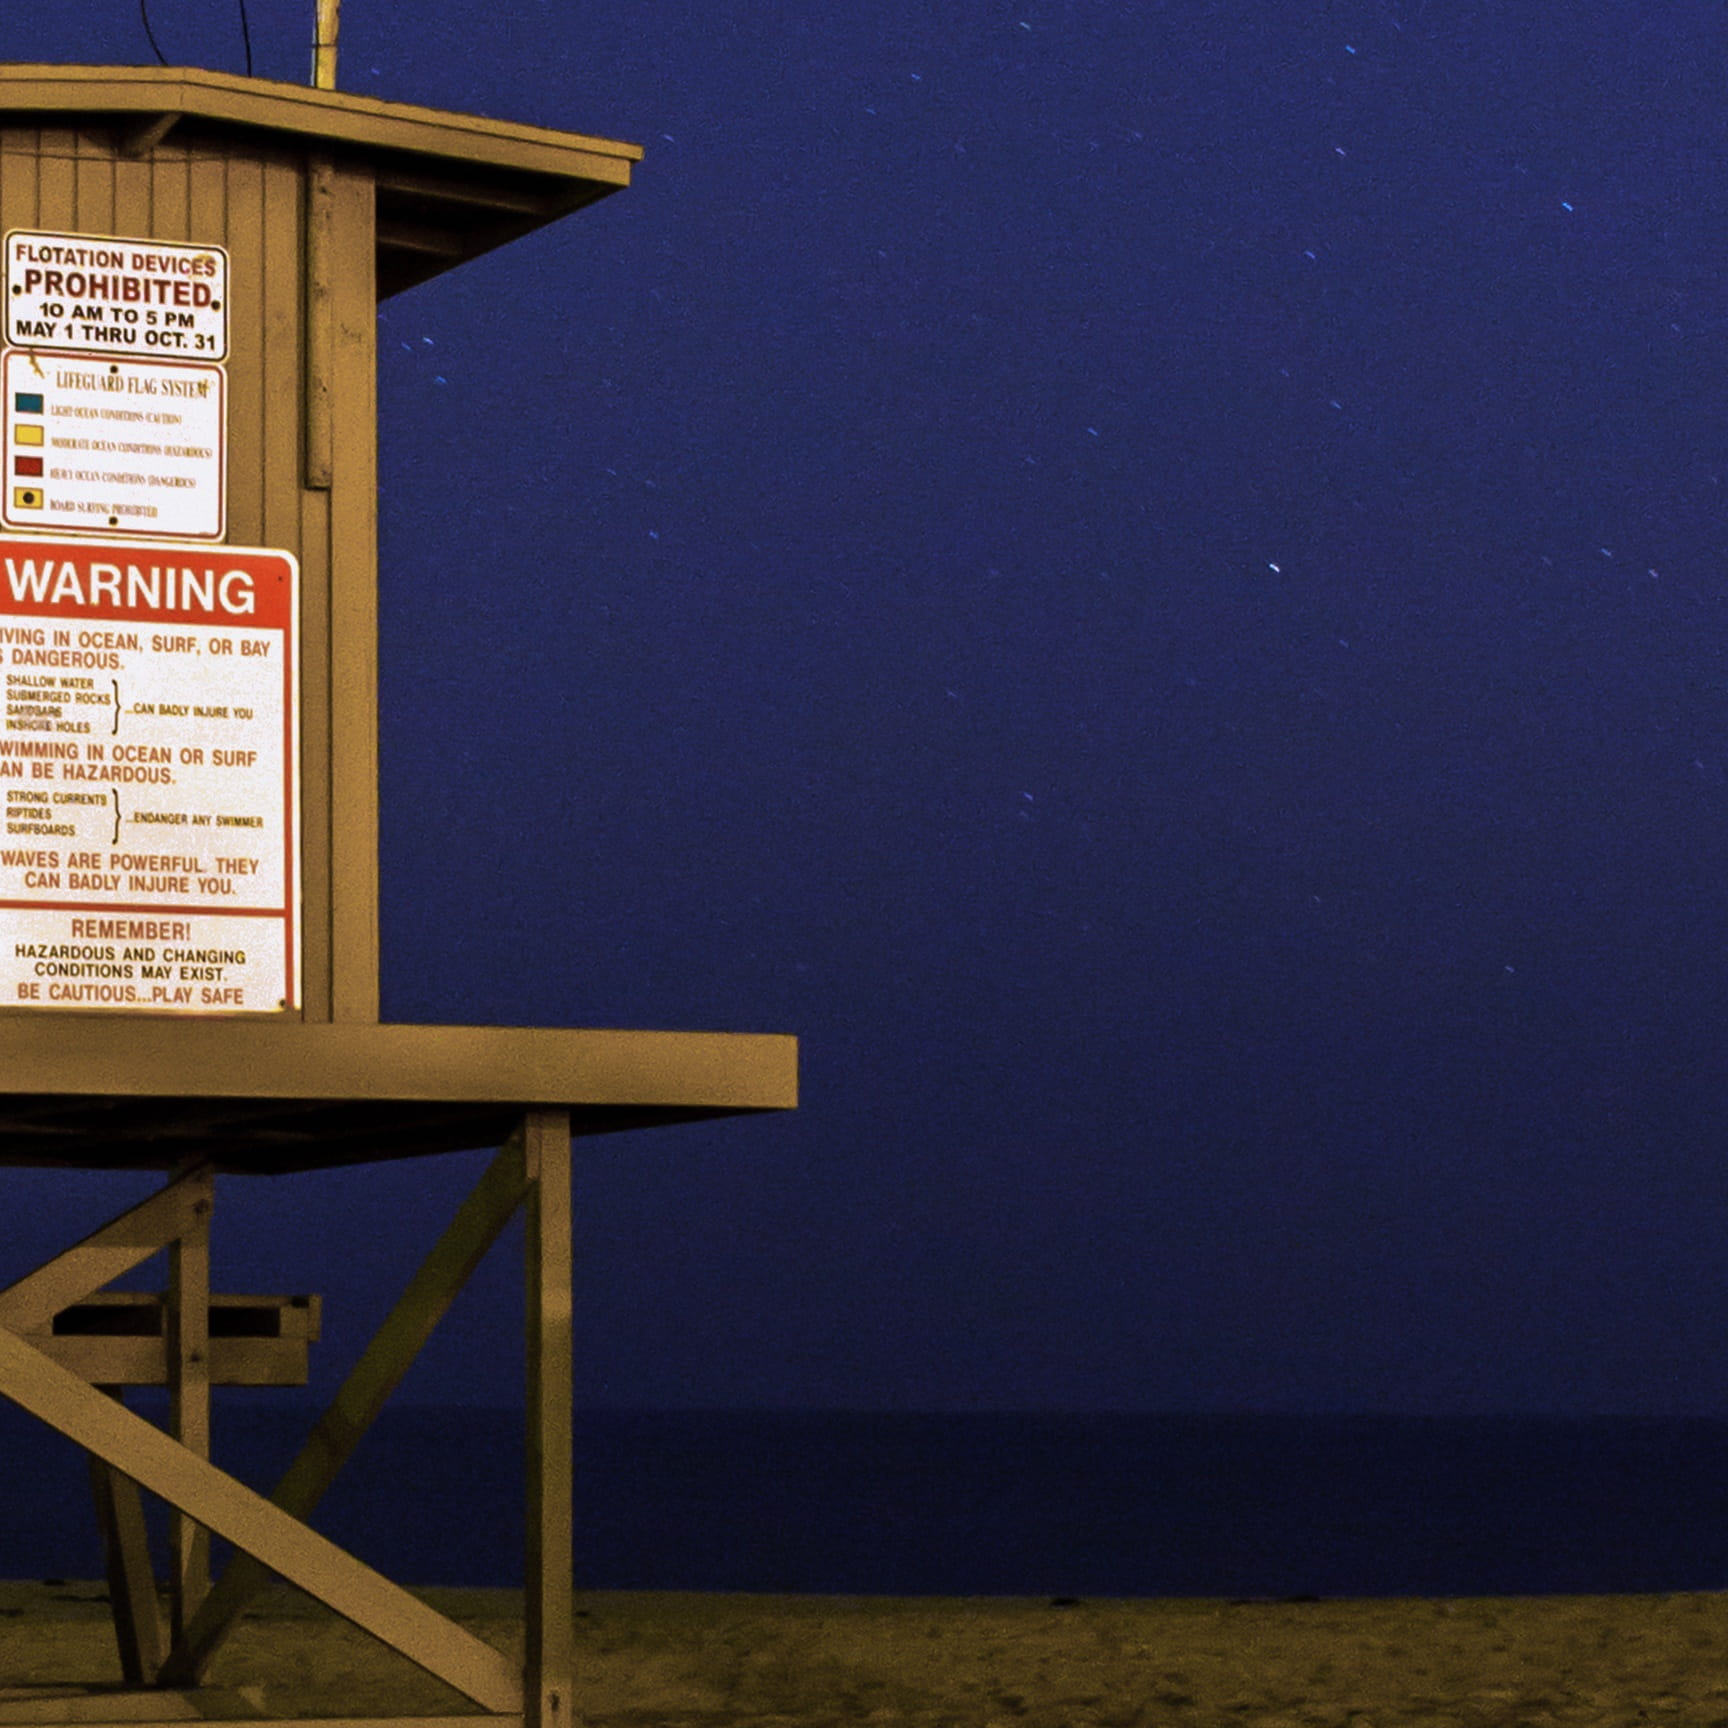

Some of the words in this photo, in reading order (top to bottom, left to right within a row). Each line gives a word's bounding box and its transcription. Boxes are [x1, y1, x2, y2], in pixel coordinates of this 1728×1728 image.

[16, 244, 124, 269] FLOTATION
[132, 253, 217, 277] DEVICES
[24, 269, 212, 308] PROHIBITED
[39, 302, 64, 318] 10
[71, 305, 104, 321] AM
[110, 307, 139, 324] TO
[146, 311, 158, 325] 5
[165, 312, 194, 328] PM
[16, 320, 58, 337] MAY
[64, 324, 73, 339] 1
[81, 325, 136, 343] THRU
[145, 330, 188, 348] OCT.
[195, 334, 215, 351] 31
[56, 371, 124, 391] LIFEGUARD
[128, 377, 157, 395] FLAG
[161, 381, 209, 399] SYSTEM
[5, 558, 256, 614] WARNING
[53, 630, 70, 647] IN
[80, 631, 143, 652] OCEAN,
[152, 635, 201, 655] SURF,
[208, 638, 233, 655] OR
[241, 639, 271, 658] BAY
[12, 649, 125, 670] DANGEROUS.
[5, 674, 57, 688] SHALLOW
[60, 677, 94, 689] WATER
[5, 690, 71, 704] SUBMERGED
[75, 692, 112, 705] ROCKS
[159, 705, 189, 717] BADLY
[193, 706, 229, 718] INJURE
[233, 708, 254, 719] YOU
[55, 722, 91, 734] HOLES
[86, 744, 104, 760] IN
[112, 745, 172, 763] OCEAN
[179, 748, 204, 764] OR
[212, 750, 257, 767] SURF
[32, 762, 54, 779] BE
[63, 763, 177, 785] HAZARDOUS.
[6, 791, 49, 803] STRONG
[52, 793, 107, 806] CURRENTS
[6, 807, 52, 819] RIPTIDES
[192, 815, 212, 826] ANY
[215, 815, 264, 828] SWIMMER
[6, 823, 76, 836] SURFBOARDS
[0, 850, 59, 868] WAVES
[68, 852, 101, 870] ARE
[216, 857, 259, 874] THEY
[25, 871, 61, 889] CAN
[68, 873, 122, 891] BADLY
[128, 875, 189, 893] INJURE
[198, 878, 237, 895] YOU.
[71, 919, 192, 941] REMEMBER!
[15, 944, 115, 961] HAZARDOUS
[123, 947, 155, 961] AND
[162, 949, 246, 964] CHANGING
[35, 962, 133, 978] CONDITIONS
[141, 965, 172, 979] MAY
[179, 967, 228, 982] EXIST.
[18, 982, 40, 999] BE
[201, 987, 243, 1005] SAFE
